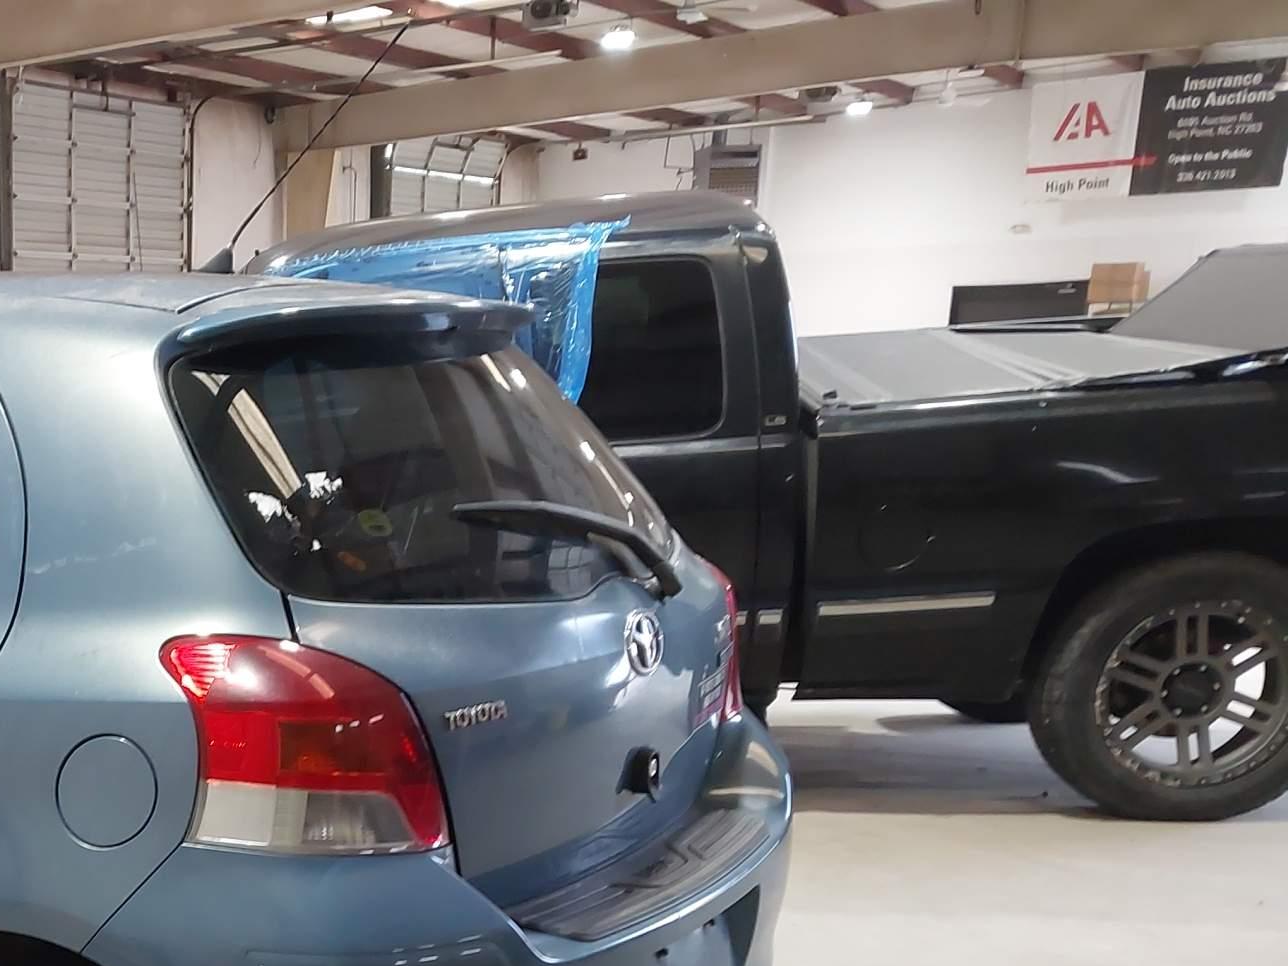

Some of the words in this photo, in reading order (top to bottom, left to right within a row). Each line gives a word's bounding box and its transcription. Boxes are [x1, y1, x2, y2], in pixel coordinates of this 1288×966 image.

[1183, 72, 1263, 92] Insurance
[1164, 95, 1202, 112] Auto
[1204, 88, 1277, 108] Auctions
[1217, 124, 1232, 136] NC
[1168, 153, 1192, 166] Open
[1193, 152, 1203, 163] to
[1204, 150, 1220, 161] the
[1220, 147, 1253, 161] Public
[1045, 180, 1074, 194] High
[1078, 177, 1110, 191] Point
[443, 700, 509, 732] TOYOTA
